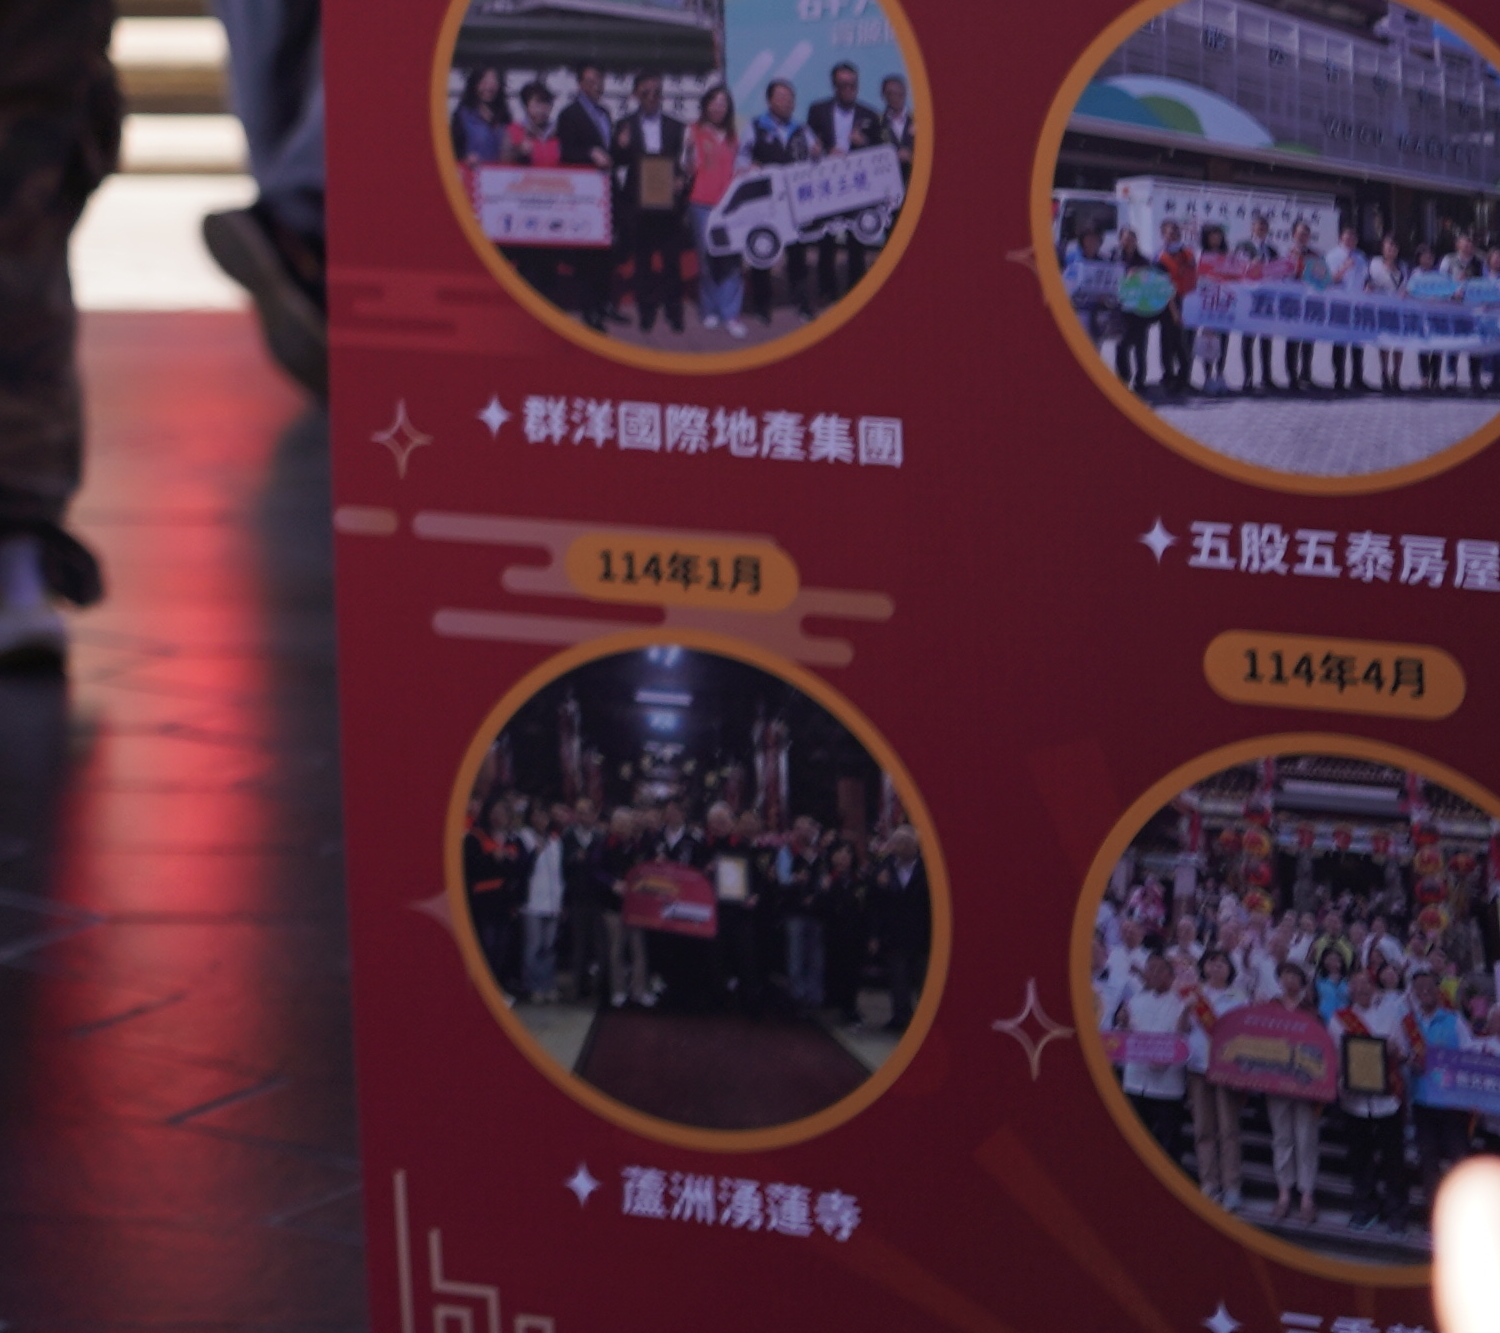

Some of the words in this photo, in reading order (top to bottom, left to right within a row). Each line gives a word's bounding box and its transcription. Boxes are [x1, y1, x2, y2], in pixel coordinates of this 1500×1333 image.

[522, 395, 904, 468] 群洋國際地產集團
[599, 549, 763, 596] 114年1月
[1187, 520, 1500, 592] 五股五泰房屋
[1244, 644, 1431, 700] 114年4月
[621, 1165, 861, 1242] 蘆洲湧蓮寺
